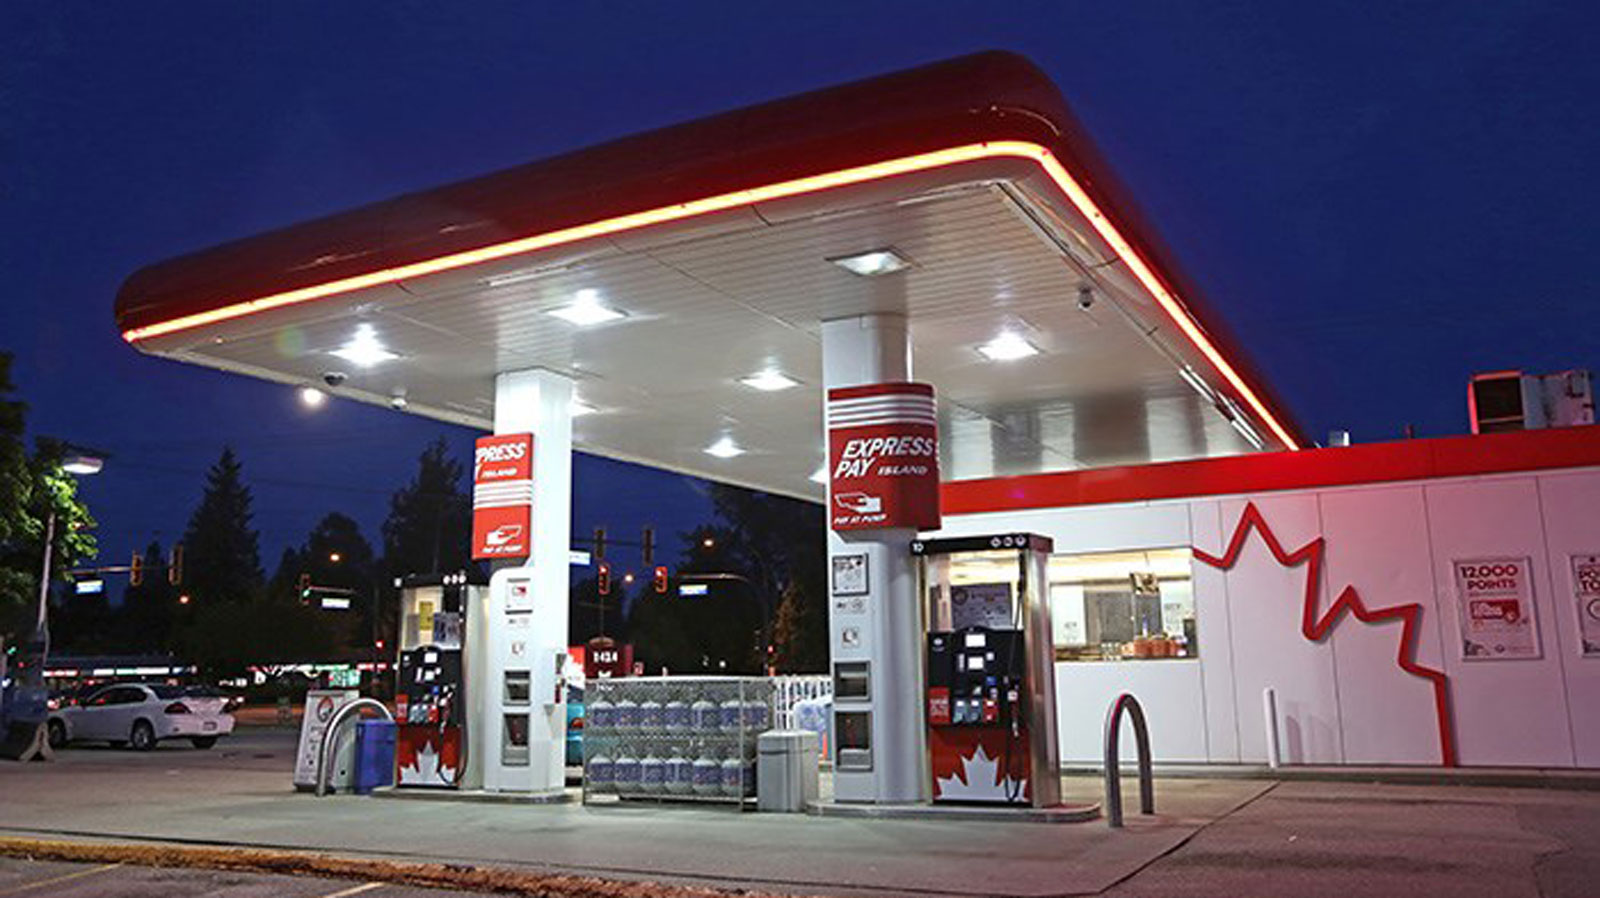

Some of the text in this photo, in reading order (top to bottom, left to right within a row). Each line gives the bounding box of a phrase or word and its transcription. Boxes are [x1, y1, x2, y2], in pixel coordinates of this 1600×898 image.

[842, 437, 934, 458] EXPRESS
[834, 457, 928, 478] PAY ISLAND
[1467, 579, 1517, 590] POINTS
